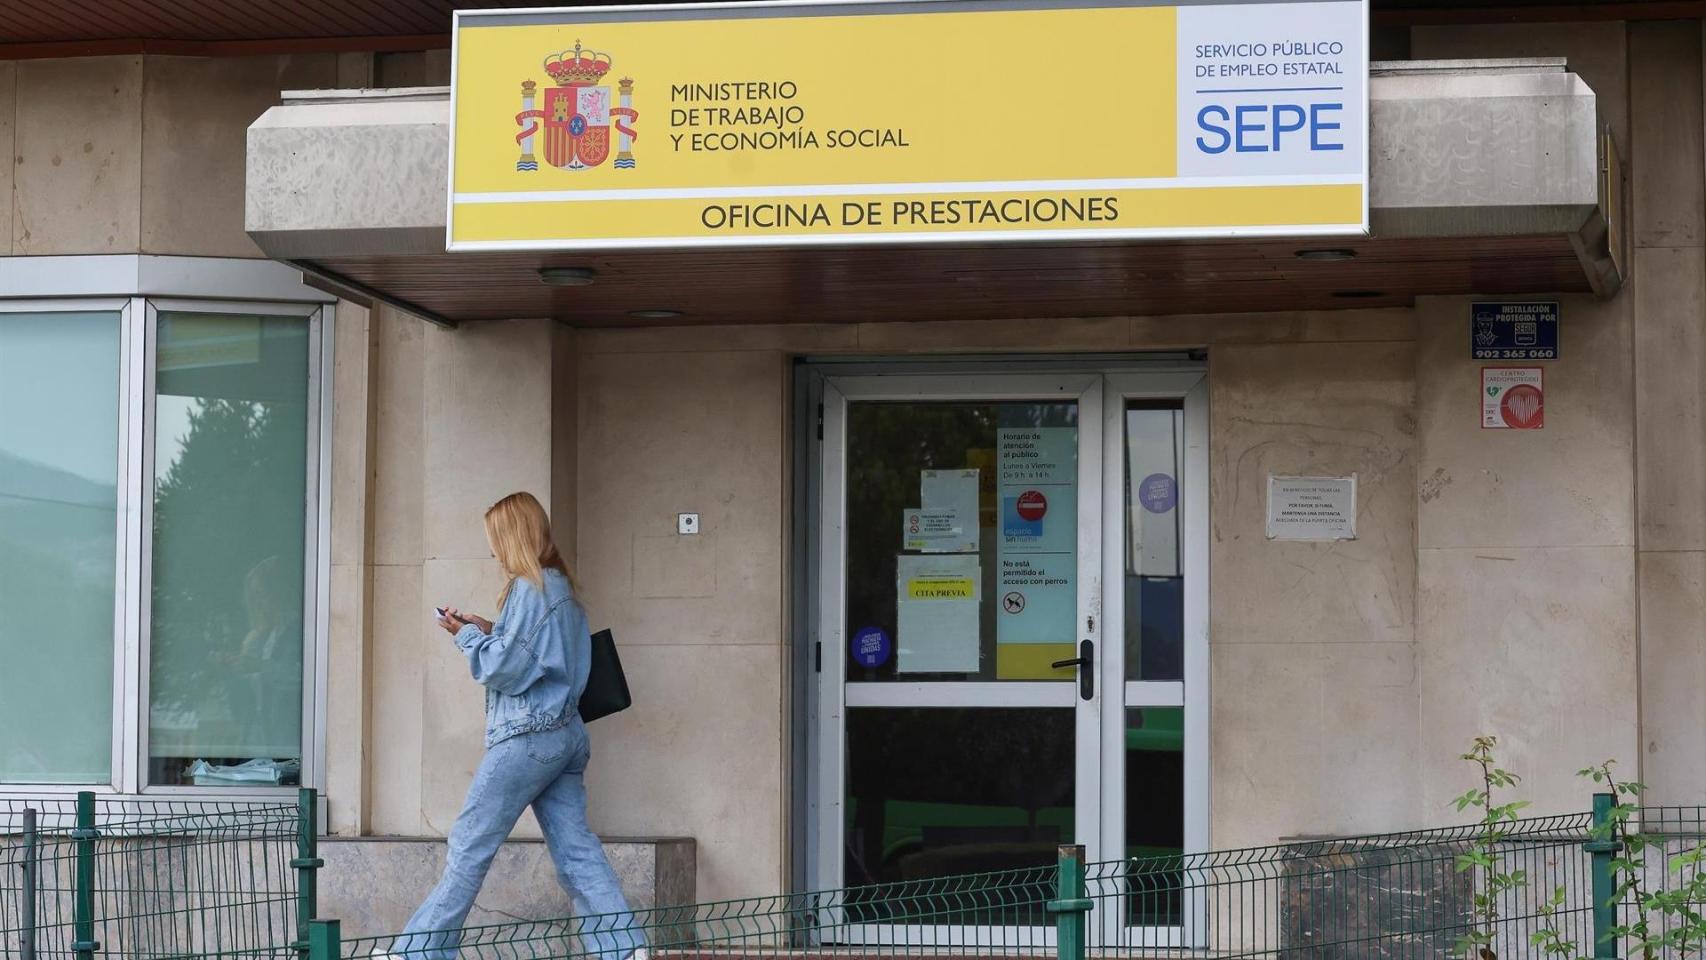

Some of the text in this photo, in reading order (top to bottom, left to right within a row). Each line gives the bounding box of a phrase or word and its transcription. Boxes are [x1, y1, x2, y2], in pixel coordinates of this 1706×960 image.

[1195, 39, 1344, 59] SERVICIO PÚBLICO
[1195, 61, 1344, 77] DE EMPLEO ESTATAL
[671, 81, 797, 102] MINISTERIO
[671, 105, 804, 128] DE TRABAJO
[1195, 103, 1344, 155] SEPE
[670, 127, 910, 152] Y ECONOMÍA SOCIAL
[701, 197, 1119, 229] OFICINA DE PRESTACIONES
[1502, 305, 1550, 313] INSTALACIÓN
[1496, 314, 1556, 322] PROTEGIDA POR
[1476, 350, 1554, 358] 902 365 060
[1012, 451, 1039, 459] público
[1003, 569, 1037, 577] permitido
[1045, 578, 1068, 586] perros
[915, 589, 967, 597] CITA PREVIA
